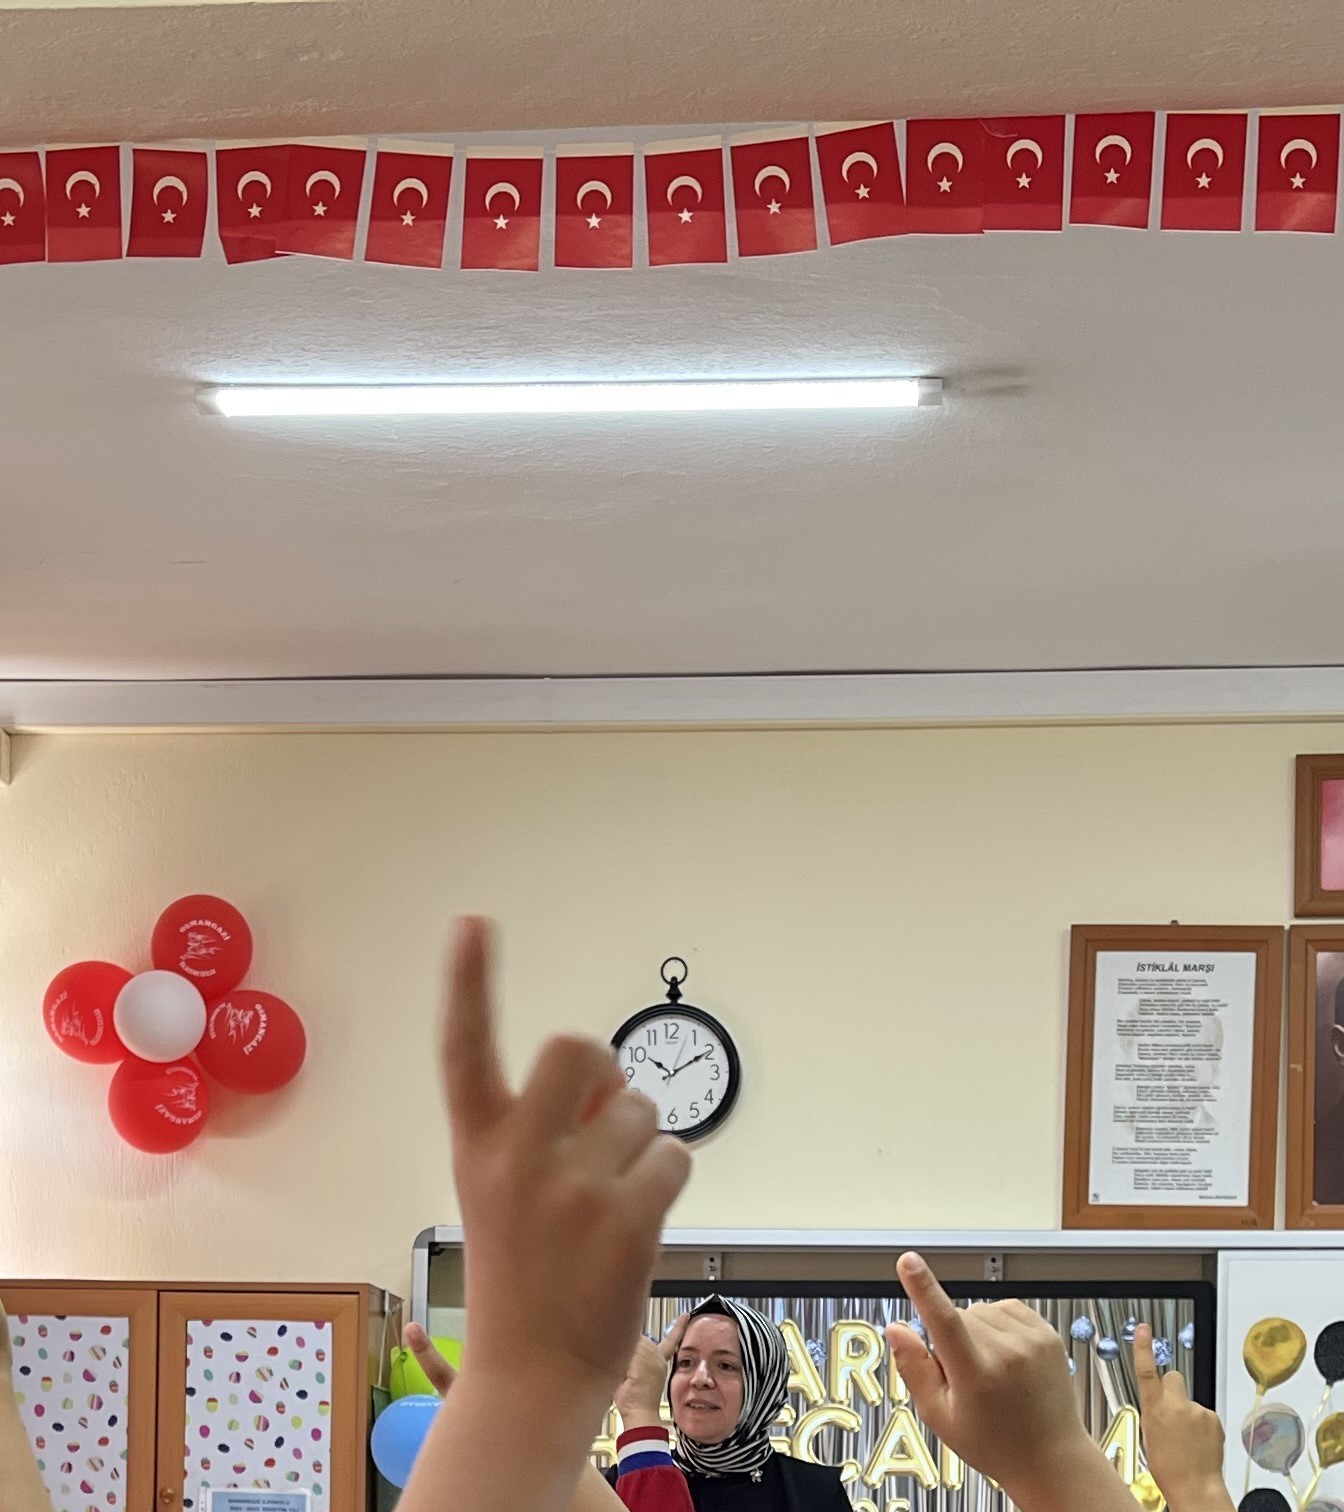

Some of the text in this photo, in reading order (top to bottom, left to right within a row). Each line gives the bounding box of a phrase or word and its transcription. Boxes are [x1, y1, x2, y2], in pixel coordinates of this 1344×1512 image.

[1182, 963, 1216, 974] MARŞI
[646, 1029, 657, 1046] 11
[664, 1022, 680, 1040] 12
[691, 1029, 697, 1046] 1
[628, 1046, 647, 1063] 10
[704, 1043, 715, 1060] 2
[624, 1066, 636, 1083] 9
[710, 1064, 721, 1081] 3
[704, 1088, 714, 1104] 4
[667, 1108, 678, 1125] 6
[689, 1102, 700, 1119] 5
